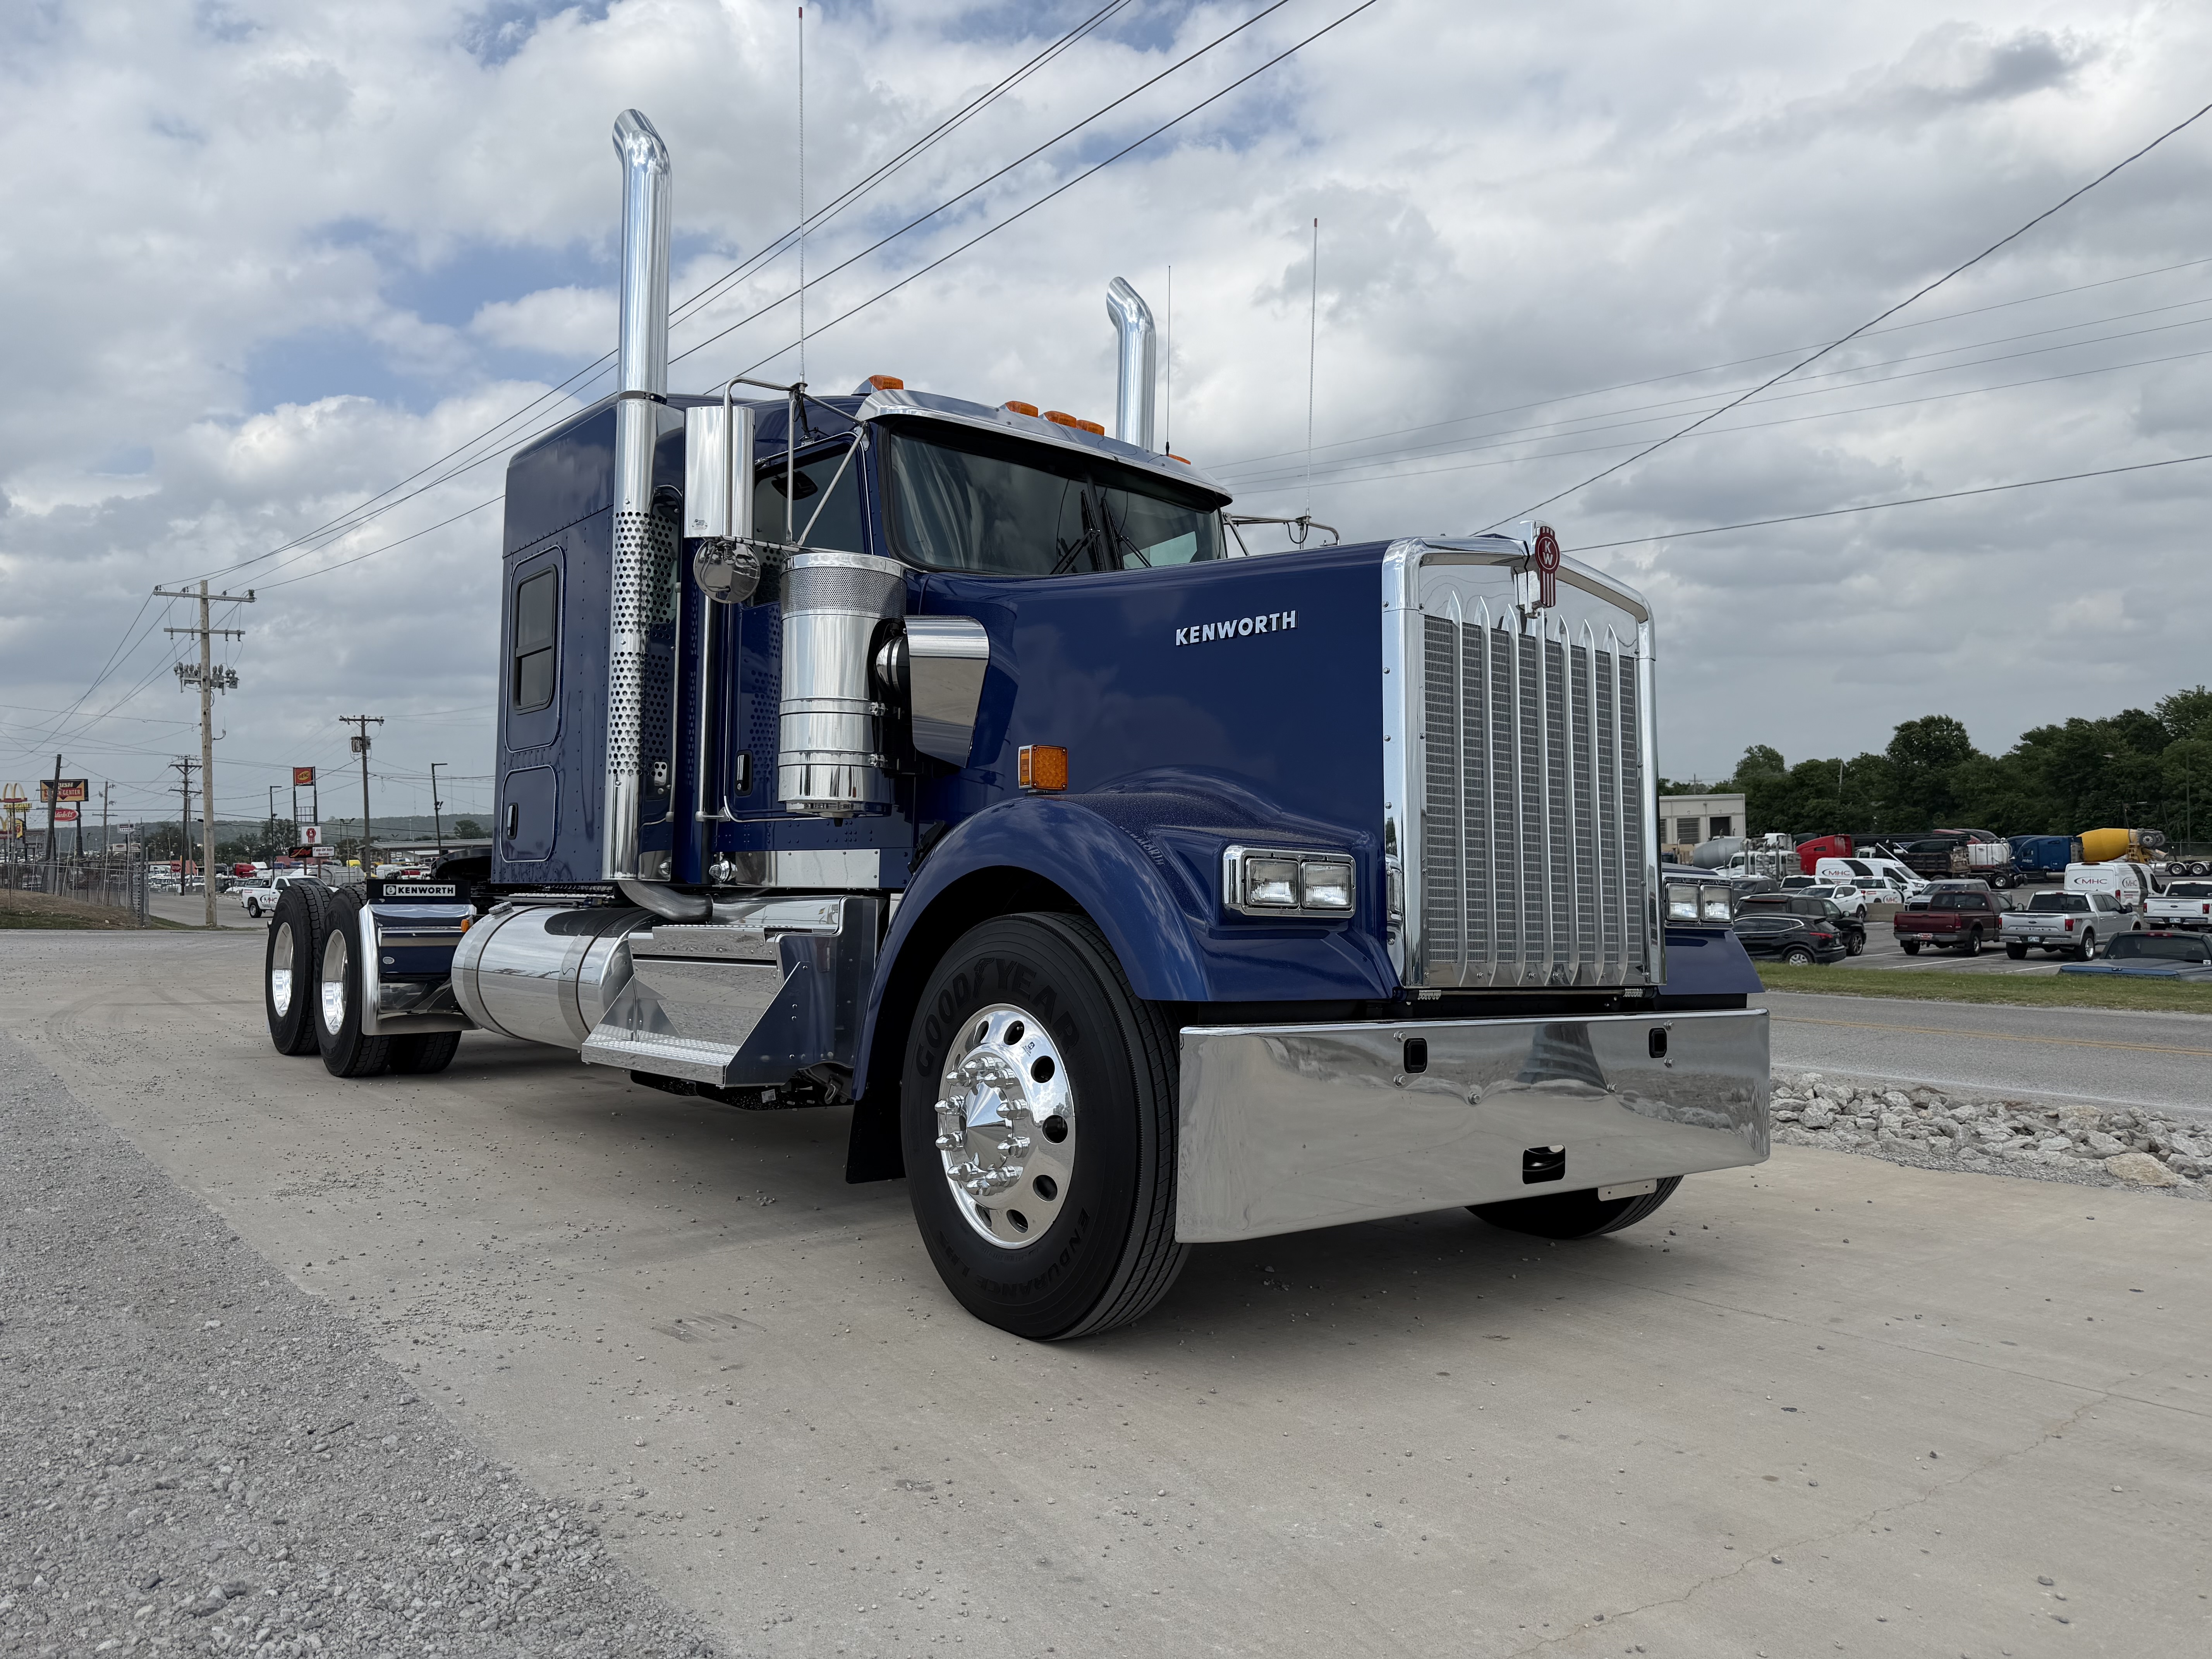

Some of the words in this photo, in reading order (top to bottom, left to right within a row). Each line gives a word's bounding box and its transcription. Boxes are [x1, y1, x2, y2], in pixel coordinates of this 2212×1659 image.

[1176, 610, 1296, 646] KENWORTH
[916, 957, 1079, 1077] GOODYEAR
[975, 1206, 1090, 1296] ENDURANCE
